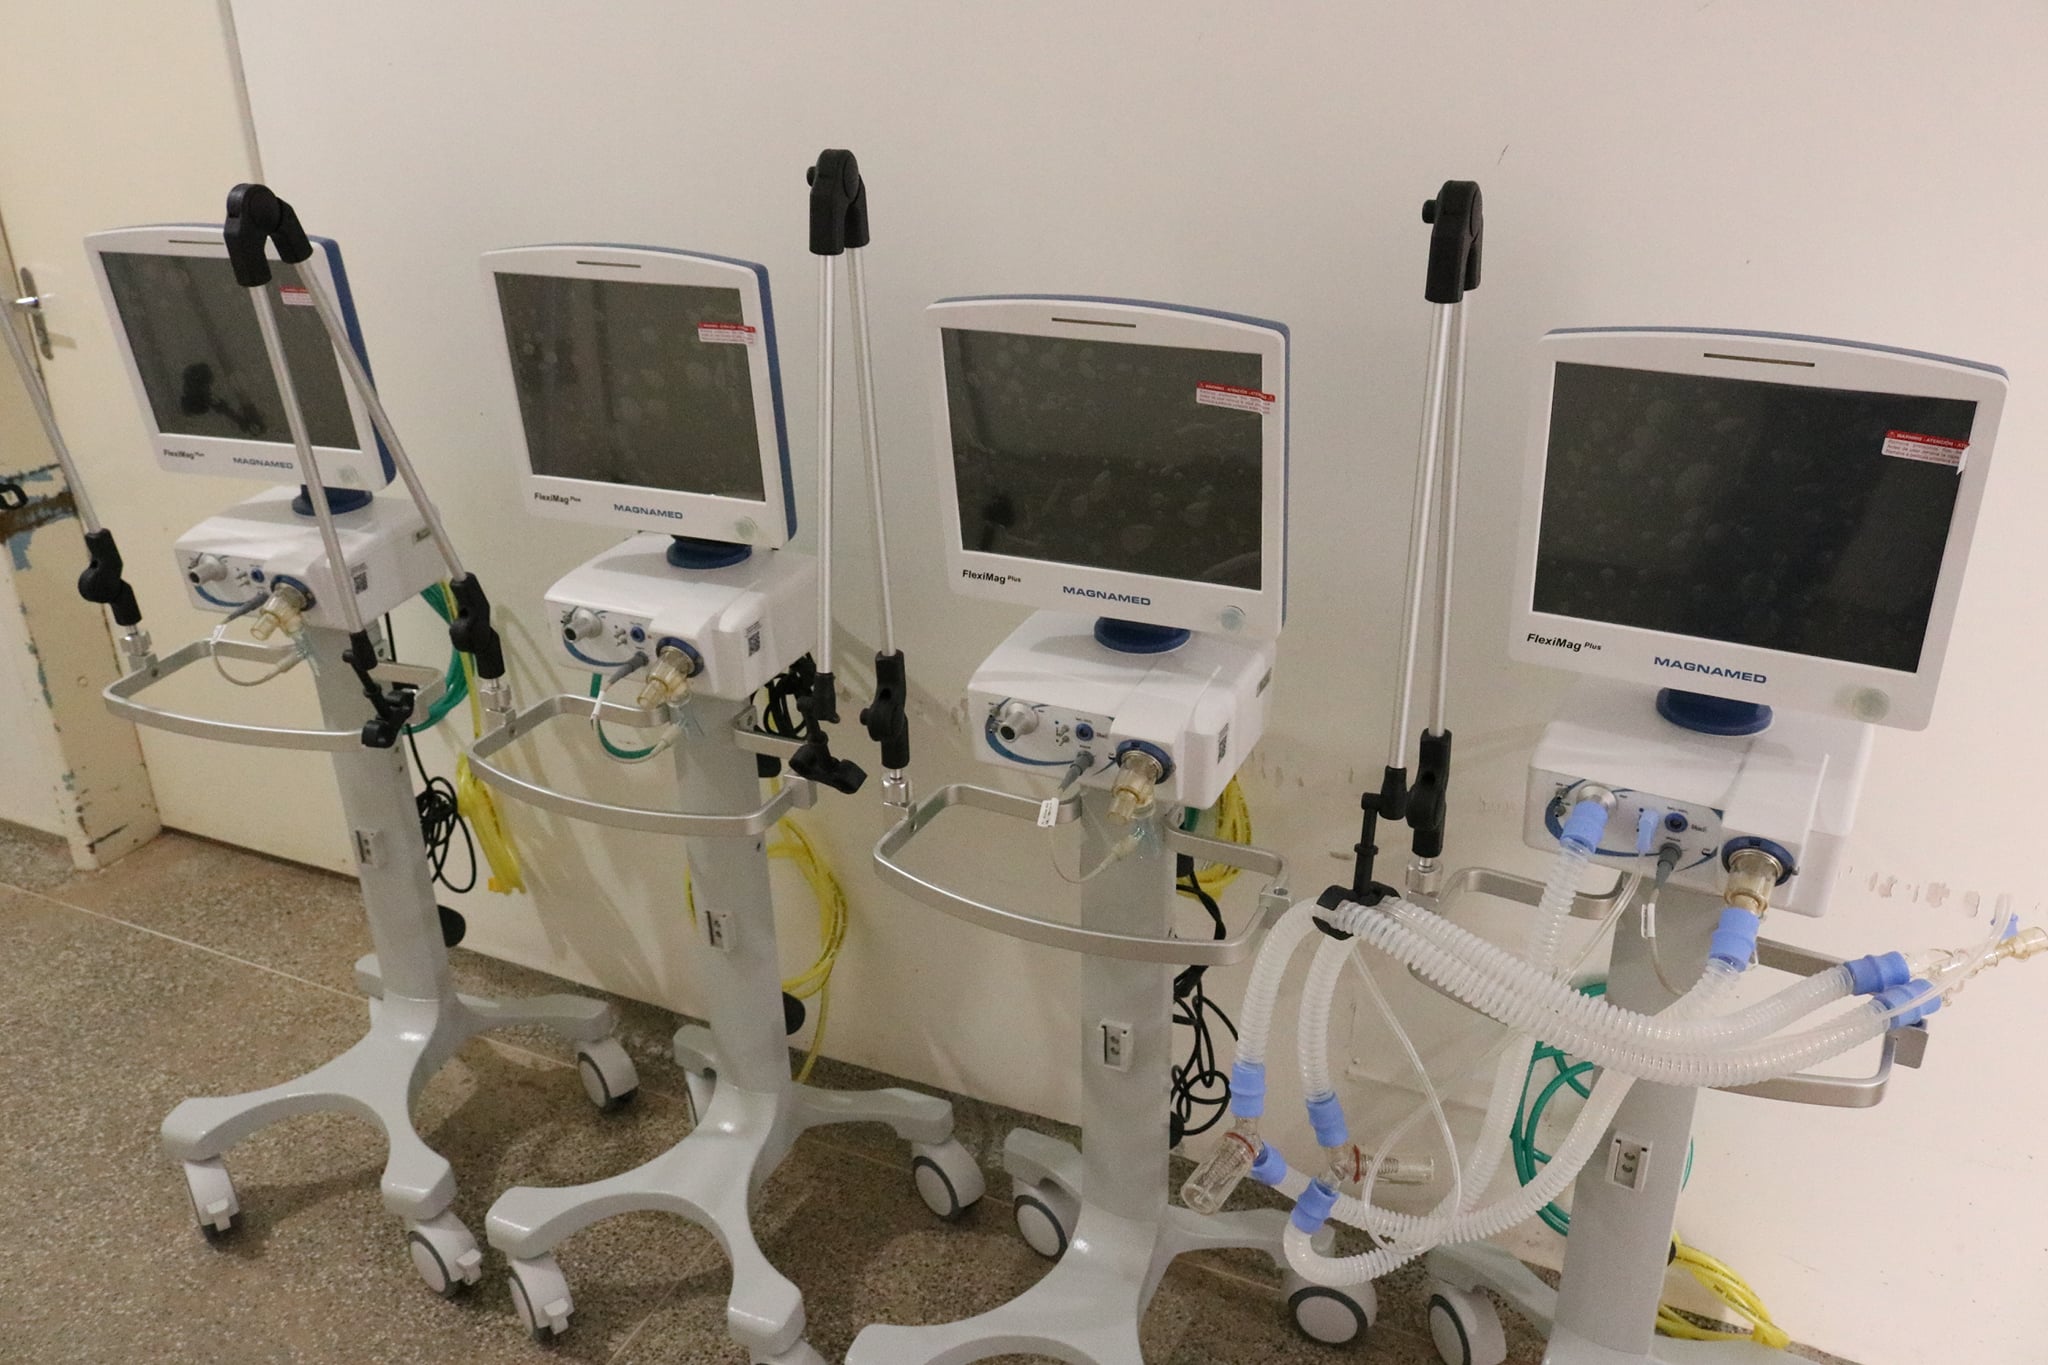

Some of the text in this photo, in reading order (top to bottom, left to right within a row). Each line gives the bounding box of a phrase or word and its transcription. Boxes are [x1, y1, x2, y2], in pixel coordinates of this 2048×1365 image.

[163, 449, 195, 460] FlexiMag
[233, 457, 294, 469] MAGNAMED
[534, 492, 569, 505] FlexiMag
[613, 503, 683, 519] MAGNAMED
[962, 569, 1021, 585] FlexiMag Plus
[1062, 585, 1151, 606] MAGNAMED
[1526, 633, 1602, 652] FlexiMag Plus
[1653, 656, 1767, 684] MAGNAMED
